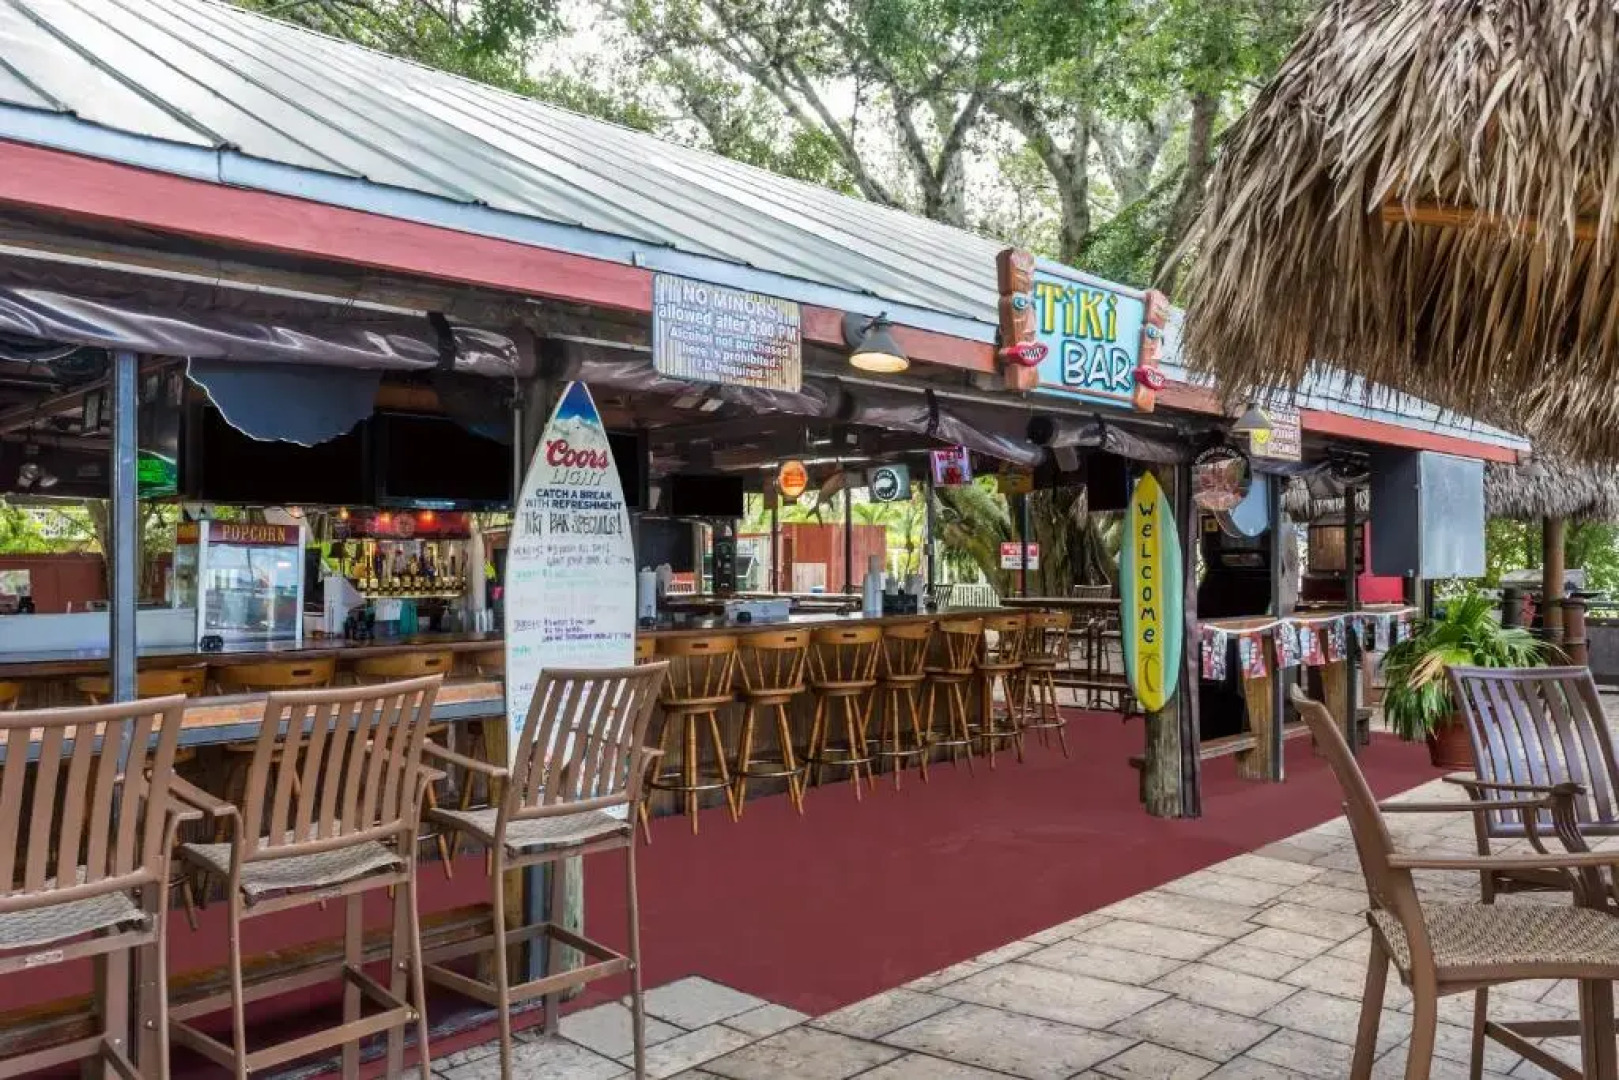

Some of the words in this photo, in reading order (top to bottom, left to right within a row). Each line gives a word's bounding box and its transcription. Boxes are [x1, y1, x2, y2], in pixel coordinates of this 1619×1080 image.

[683, 284, 708, 305] NO
[658, 304, 712, 325] allowed
[715, 314, 746, 331] after
[778, 325, 797, 342] PM
[669, 326, 714, 343] Alcohol
[715, 335, 734, 348] not
[736, 338, 789, 357] purchased
[682, 342, 706, 356] here
[1062, 340, 1133, 392] BAR
[546, 439, 609, 470] Coors
[525, 498, 549, 509] WITH
[551, 499, 623, 510] REFRESHMENT
[535, 488, 569, 499] CATCH
[570, 489, 578, 499] A
[579, 489, 613, 500] BREAK
[222, 524, 286, 542] POPCORN
